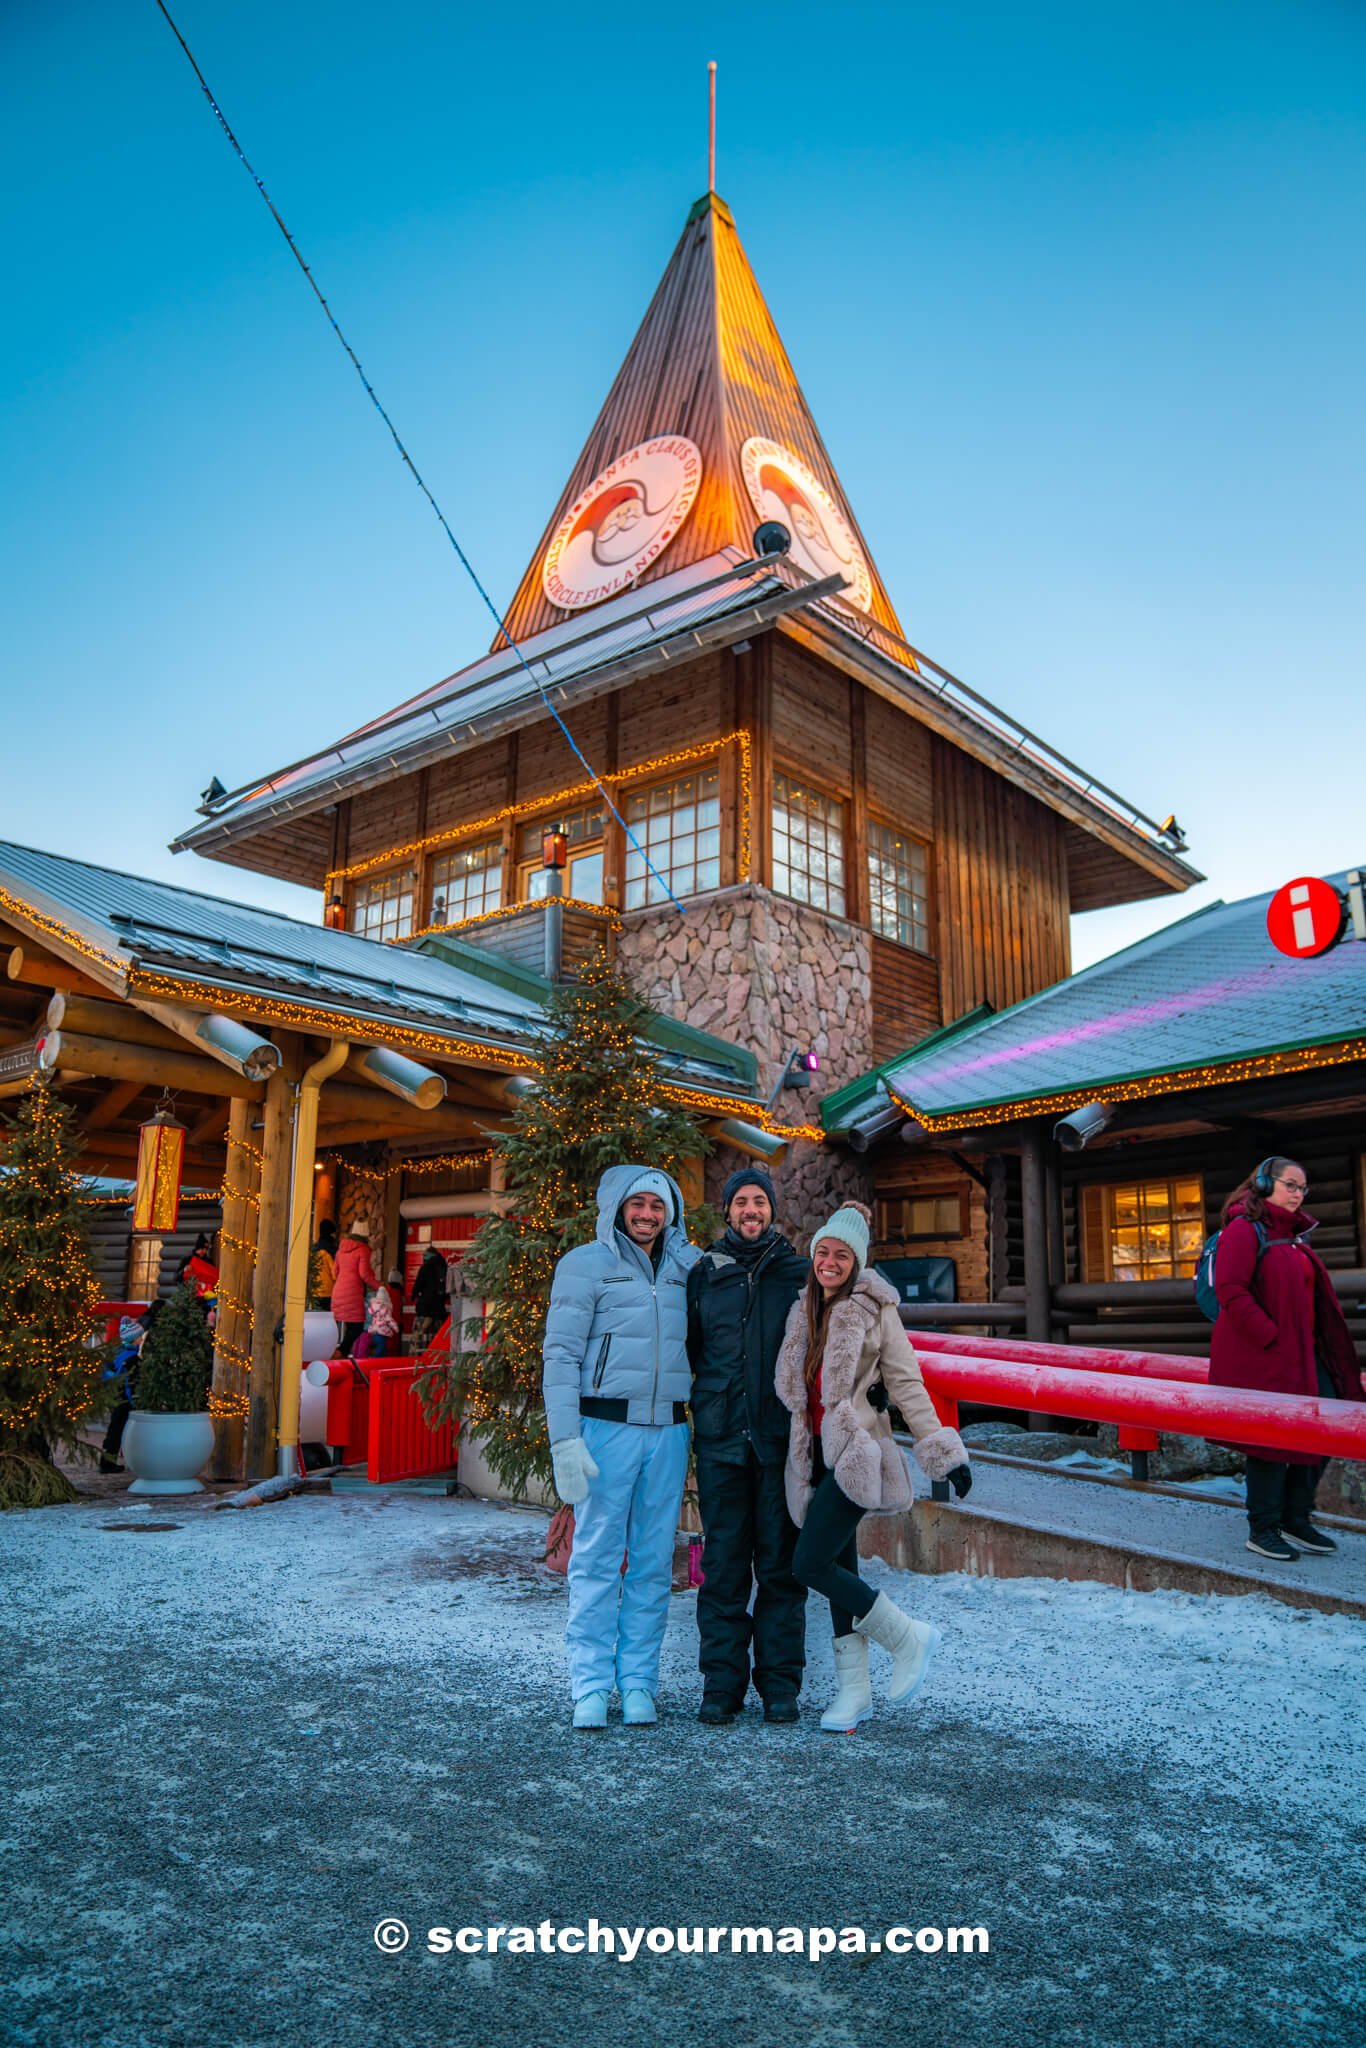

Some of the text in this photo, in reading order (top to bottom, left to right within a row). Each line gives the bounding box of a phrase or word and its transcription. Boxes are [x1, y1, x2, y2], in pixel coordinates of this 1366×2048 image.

[584, 451, 640, 500] SANTA
[646, 439, 692, 461] CLAUS
[670, 458, 698, 525] OFFICE
[546, 515, 660, 605] ARCTIC CIRCLE FINLAND
